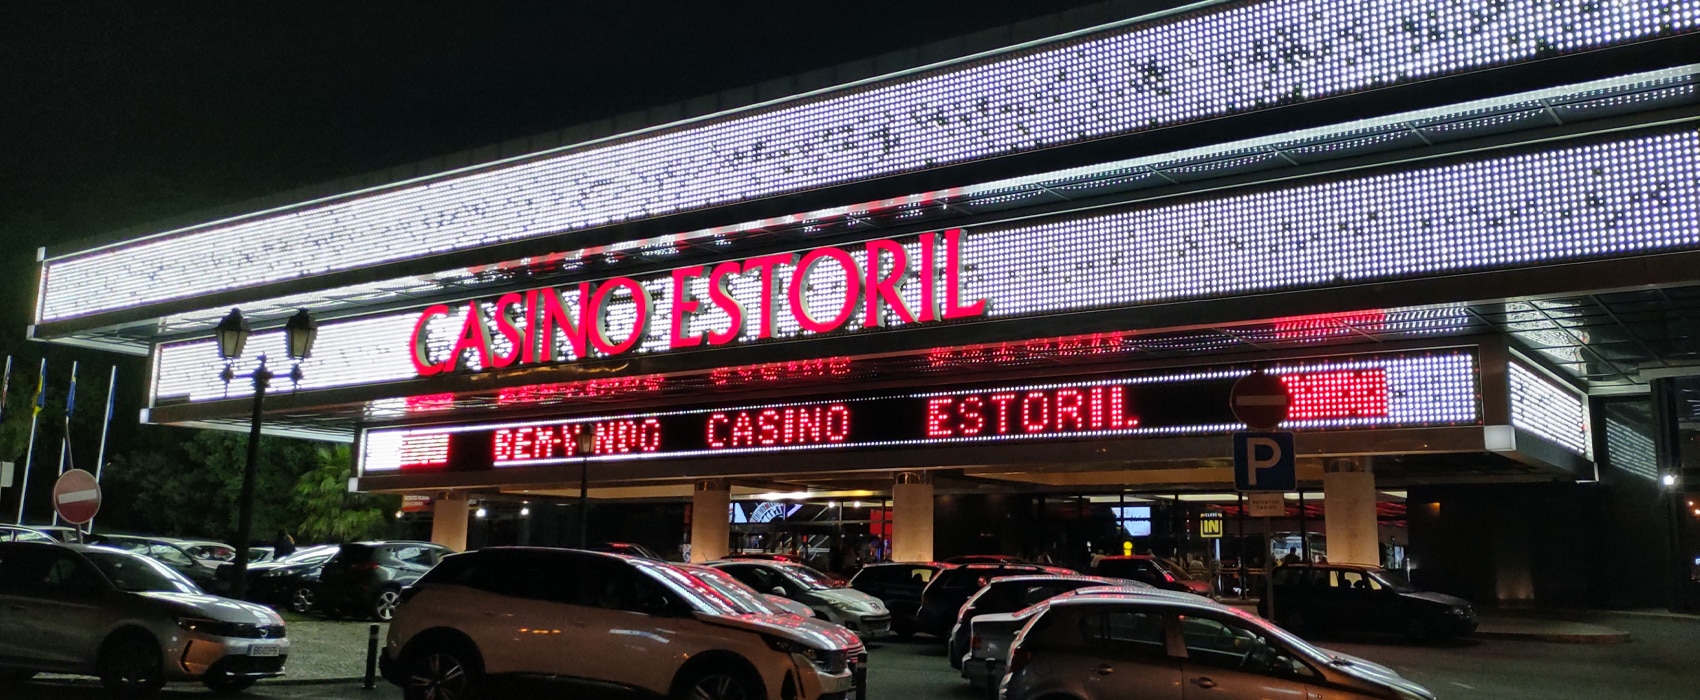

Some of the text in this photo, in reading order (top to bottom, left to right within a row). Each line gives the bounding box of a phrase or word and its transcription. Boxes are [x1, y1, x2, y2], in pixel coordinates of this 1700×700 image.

[409, 228, 988, 377] CASINO ESTORIL
[493, 386, 1139, 461] BEM-VNDO CASINO ESTORIL
[1246, 437, 1282, 486] P
[1203, 519, 1219, 533] IN
